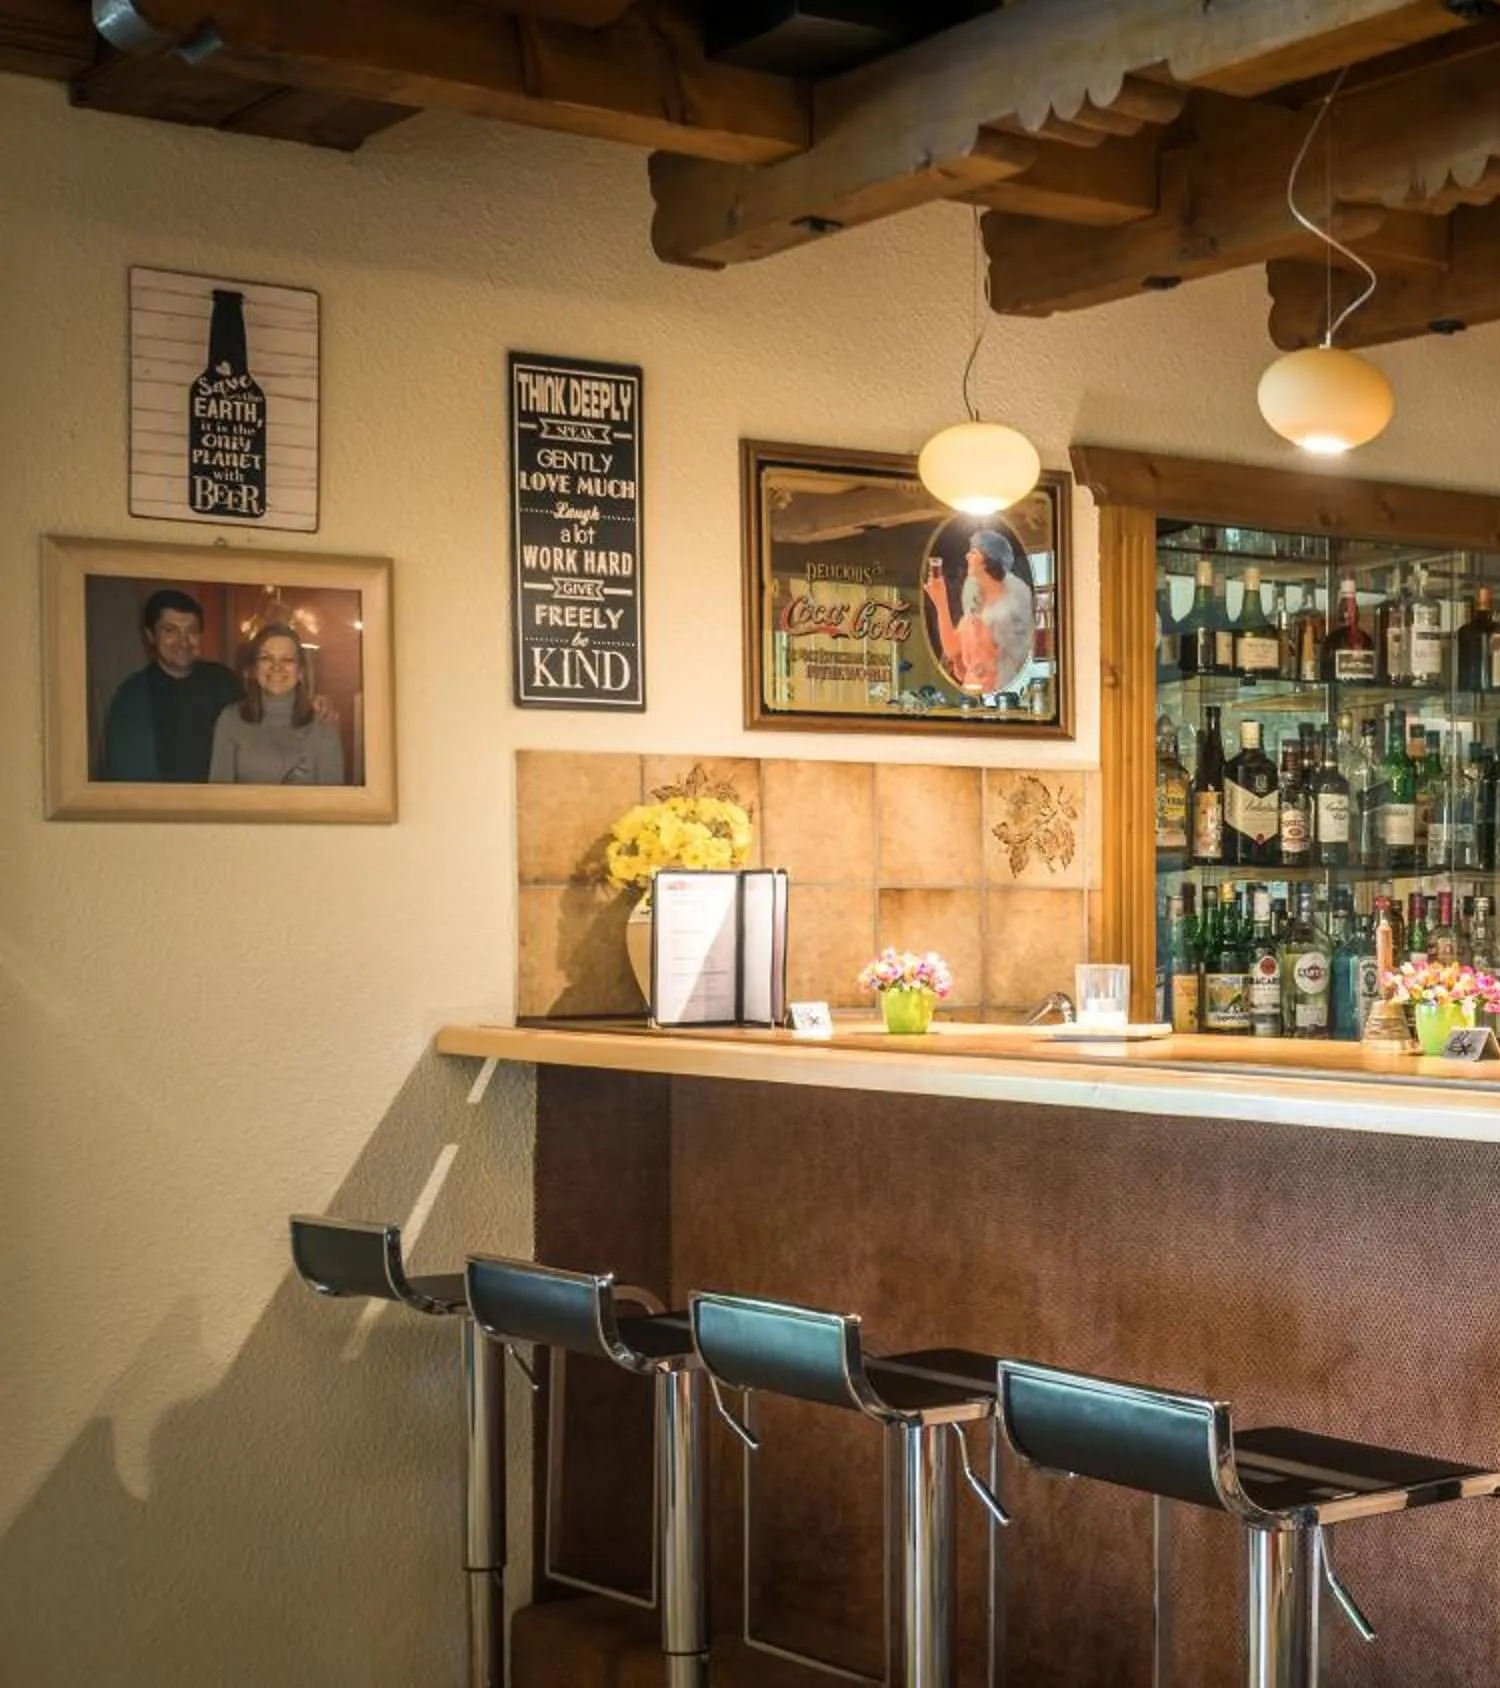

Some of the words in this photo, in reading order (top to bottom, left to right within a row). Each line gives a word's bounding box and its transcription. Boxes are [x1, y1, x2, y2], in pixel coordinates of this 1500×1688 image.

[518, 373, 567, 416] THINK
[569, 378, 632, 422] DEEPLY
[556, 425, 596, 440] SPEAK
[537, 448, 613, 473] GENTLY
[213, 470, 245, 483] with
[519, 471, 571, 494] LOVE
[577, 476, 636, 499] MUCH
[553, 501, 600, 524] Laugh
[560, 528, 572, 543] a
[573, 523, 596, 545] lot
[523, 545, 578, 573] WORK
[583, 550, 633, 577] HARD
[563, 583, 594, 595] GIVE
[535, 604, 624, 630] FREELY
[571, 631, 590, 647] be
[530, 647, 632, 692] KIND
